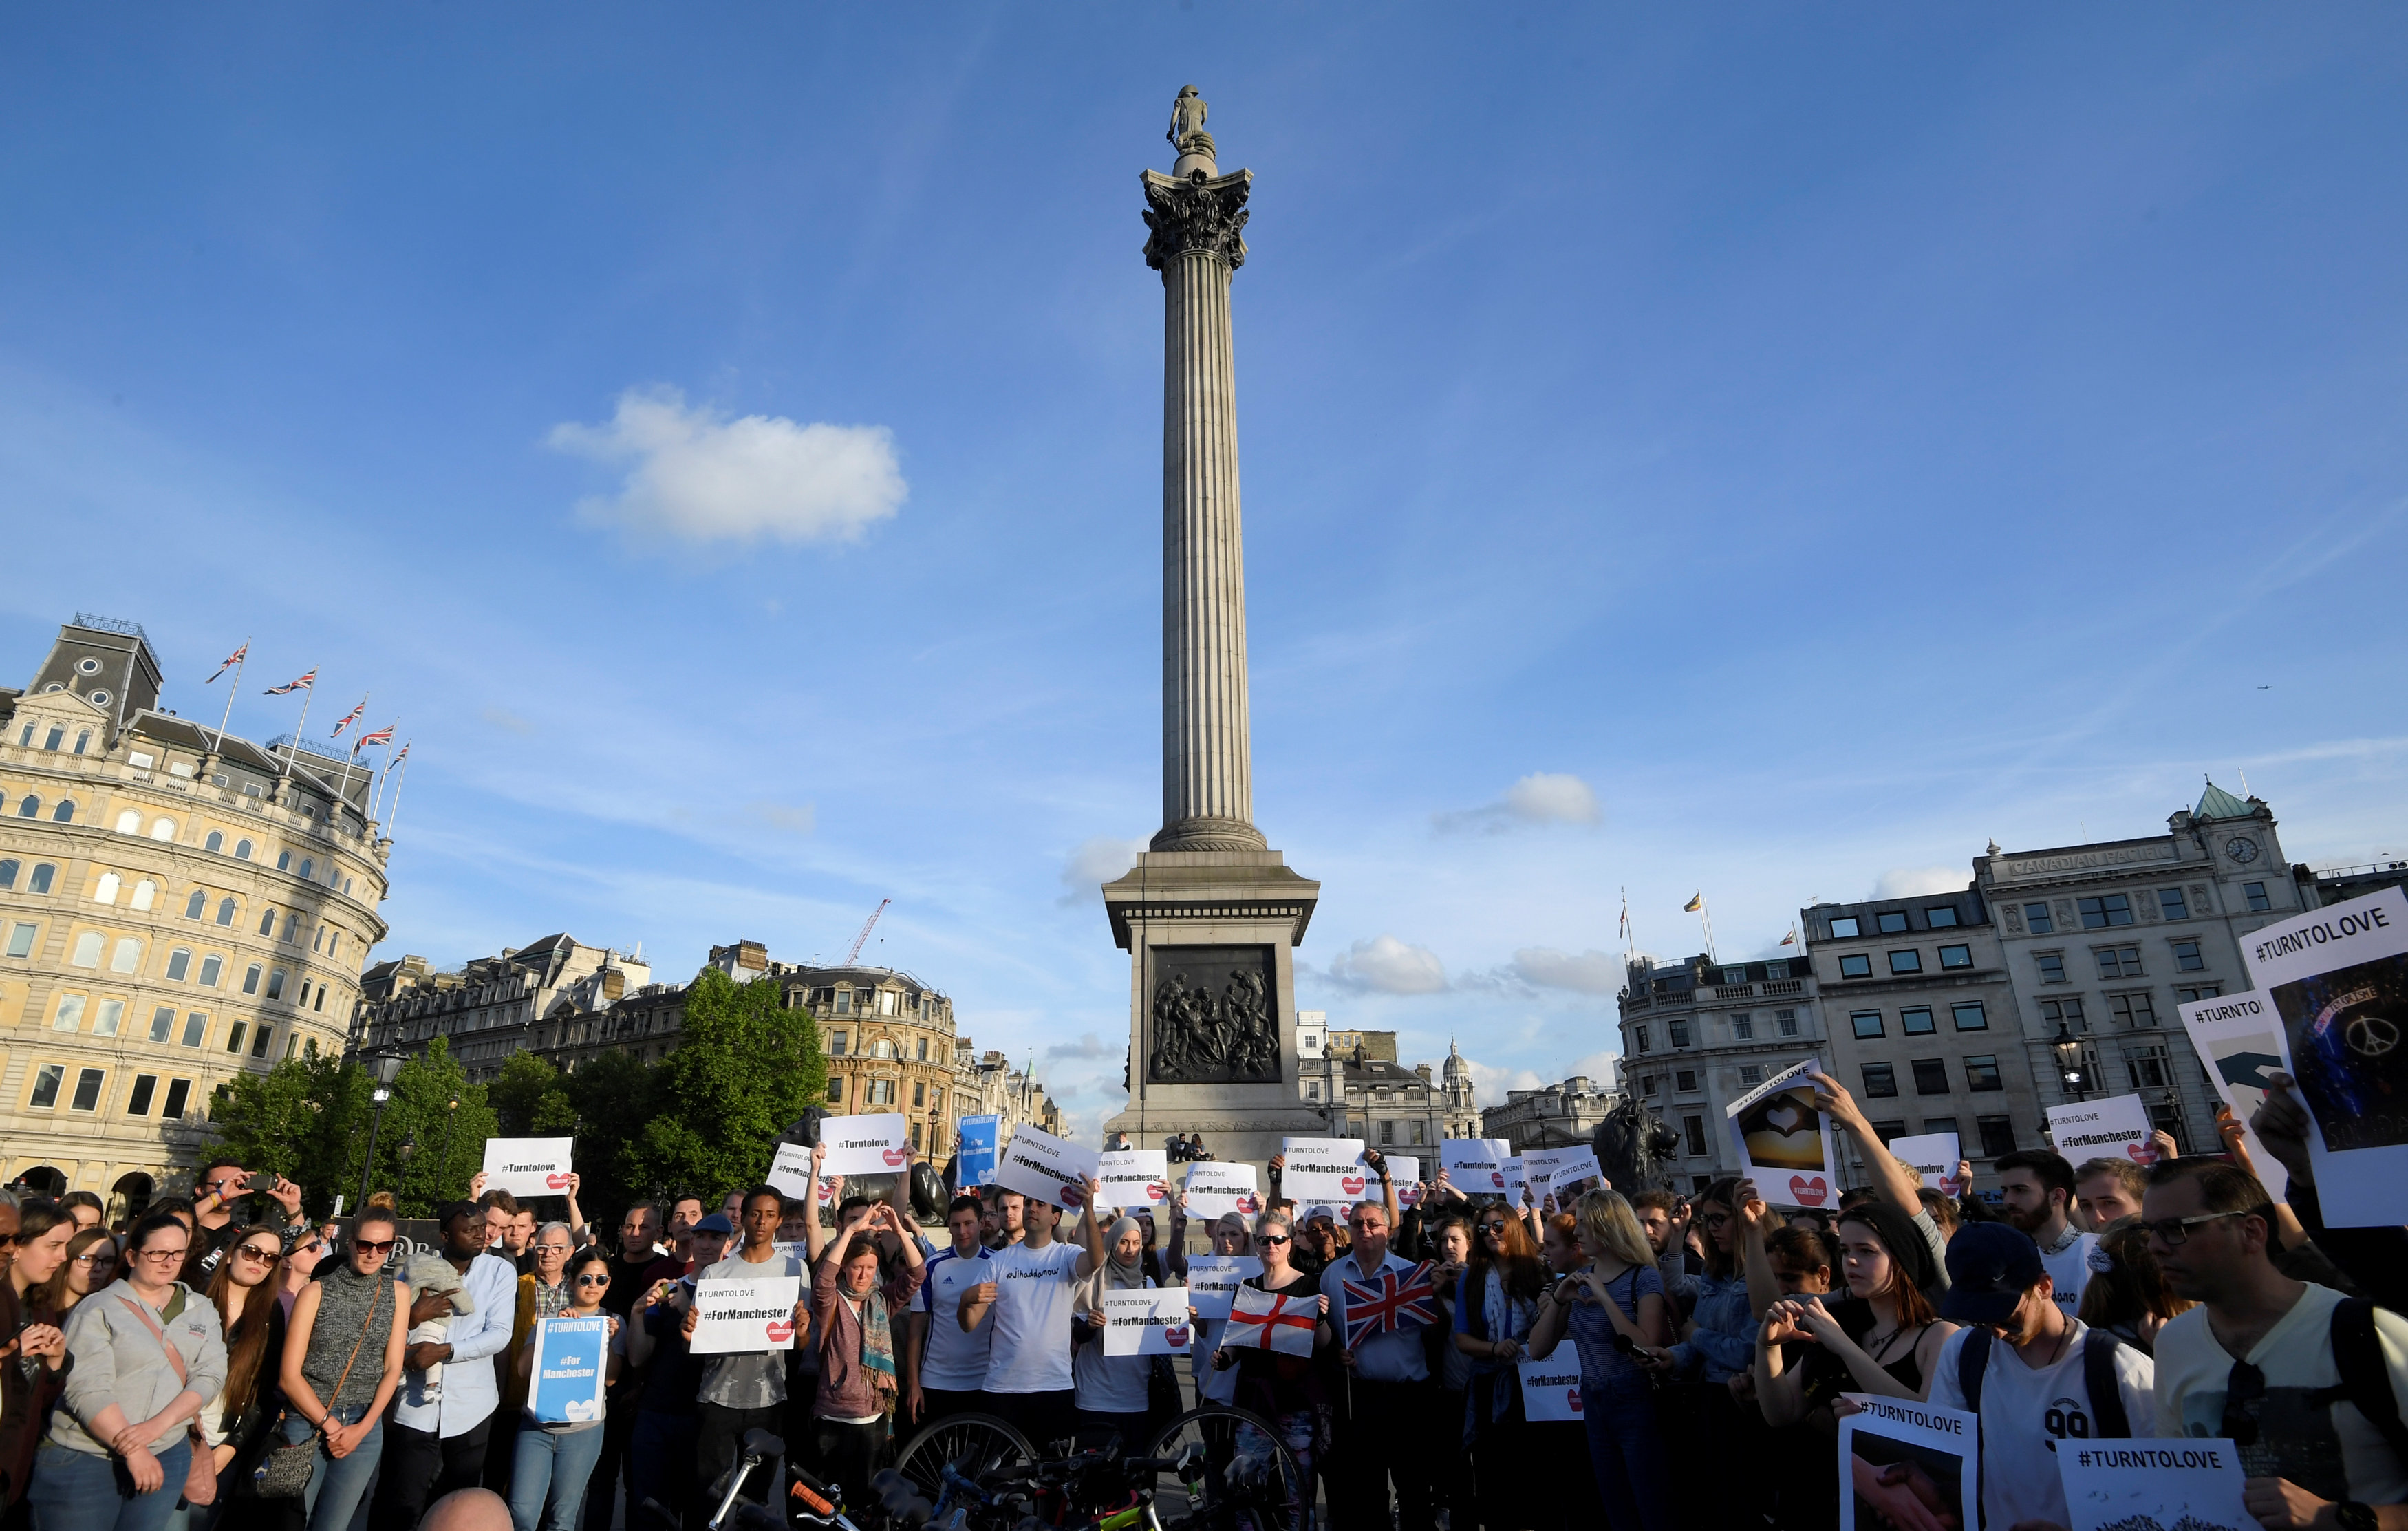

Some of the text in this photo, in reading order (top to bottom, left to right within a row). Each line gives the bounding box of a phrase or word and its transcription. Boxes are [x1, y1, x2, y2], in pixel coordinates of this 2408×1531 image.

[2013, 844, 2171, 875] CANADIAN PACIFIC
[2256, 907, 2390, 963] #TURNTOLOVE
[1737, 1066, 1809, 1108] #TURNTOLOVE
[2050, 1113, 2100, 1126] #TURNTOLOVE
[838, 1139, 890, 1149] #Turntolove
[2061, 1129, 2142, 1148] #ForManchester
[1013, 1133, 1061, 1158] #TURNTOLOVE
[1454, 1161, 1497, 1170] #Turntolove
[1523, 1157, 1560, 1166] #TURNTOLOVE
[502, 1164, 555, 1173] #Turntolove
[1290, 1163, 1357, 1174] #ForManchester
[1553, 1161, 1593, 1180] #TURNTOLOVE
[1189, 1186, 1251, 1195] #ForManchester
[1194, 1281, 1238, 1292] #ForManch
[698, 1289, 755, 1298] #TURNTOLOVE
[704, 1308, 788, 1320] #ForManchester
[548, 1320, 601, 1333] #TURNTOLOVE
[1112, 1316, 1182, 1327] #ForManchester
[560, 1356, 581, 1366] #For
[542, 1369, 595, 1379] Manchester
[1527, 1374, 1579, 1388] #ForManchester
[1860, 1400, 1963, 1435] #TURNTOLOVE
[2078, 1450, 2222, 1471] #TURNTOLOVE
